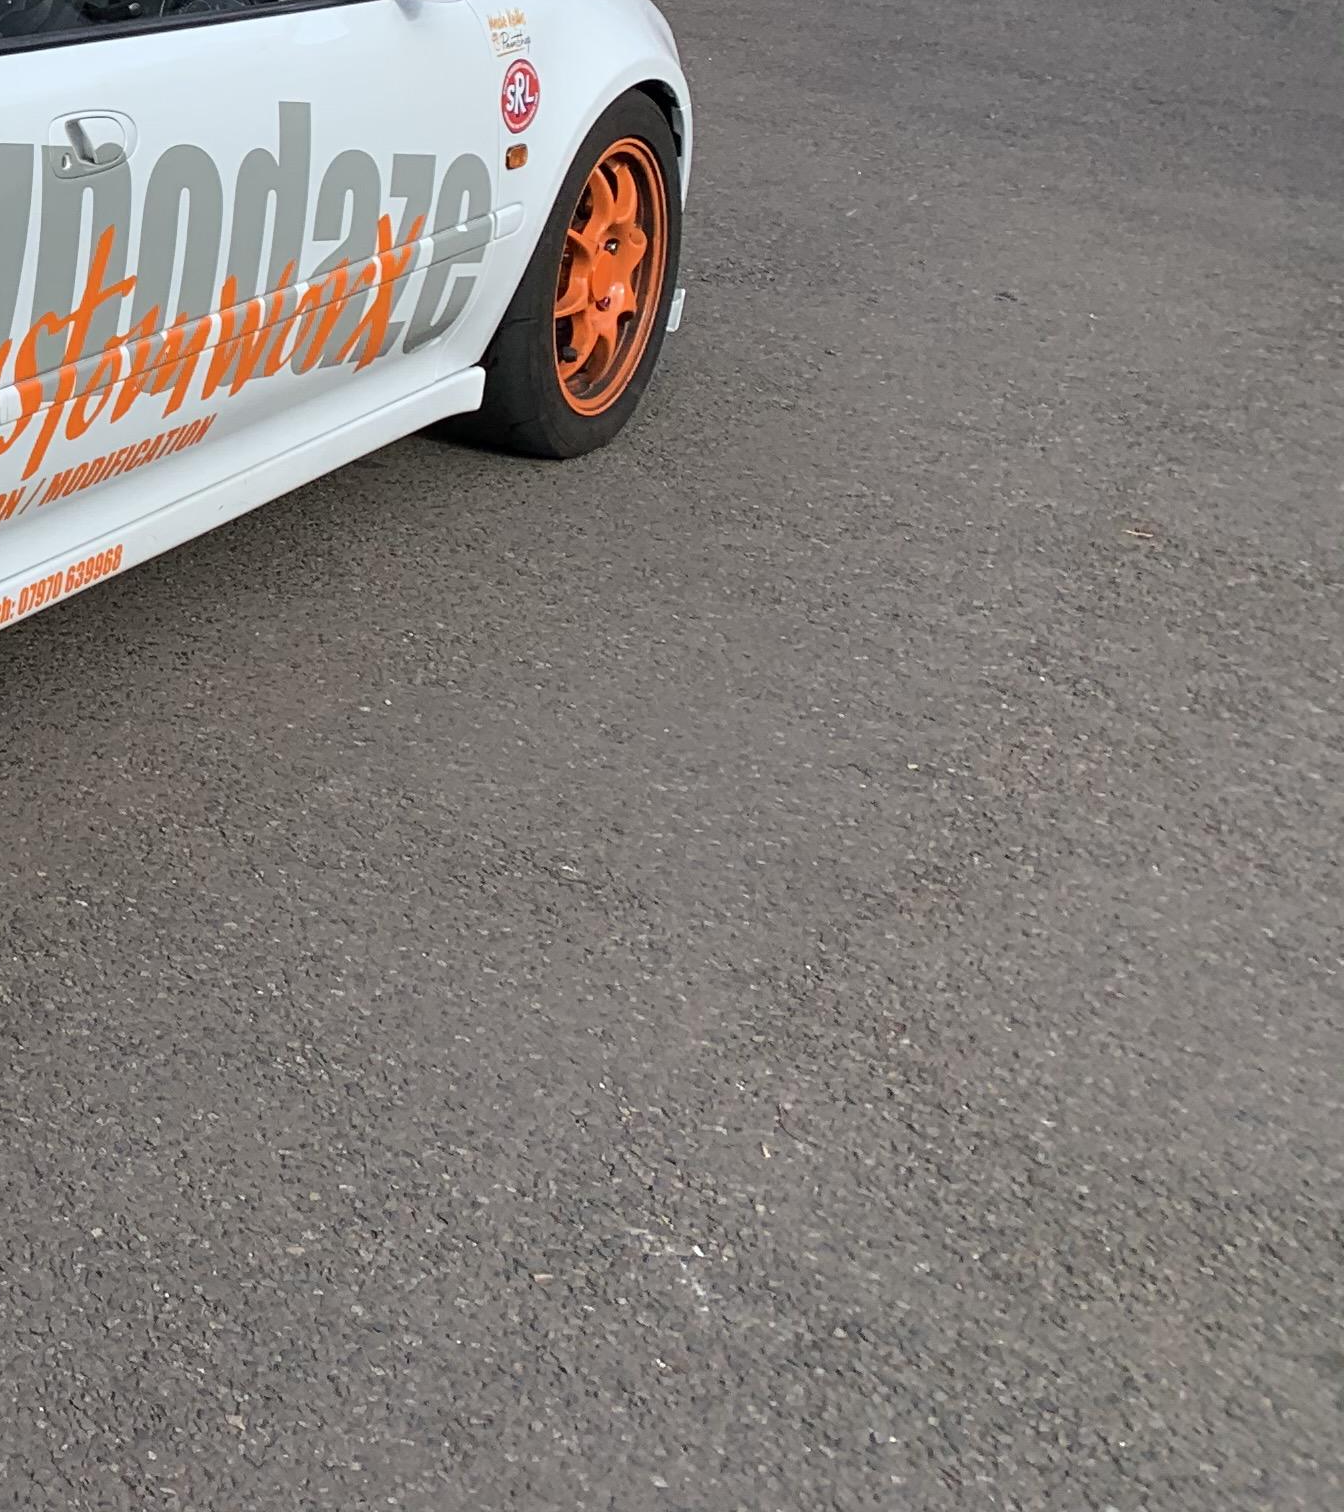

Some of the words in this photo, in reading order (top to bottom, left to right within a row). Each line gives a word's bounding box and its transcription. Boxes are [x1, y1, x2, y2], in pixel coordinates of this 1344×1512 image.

[38, 412, 219, 507] MODIFICATION
[17, 575, 62, 616] 07970
[64, 544, 124, 595] 639968
